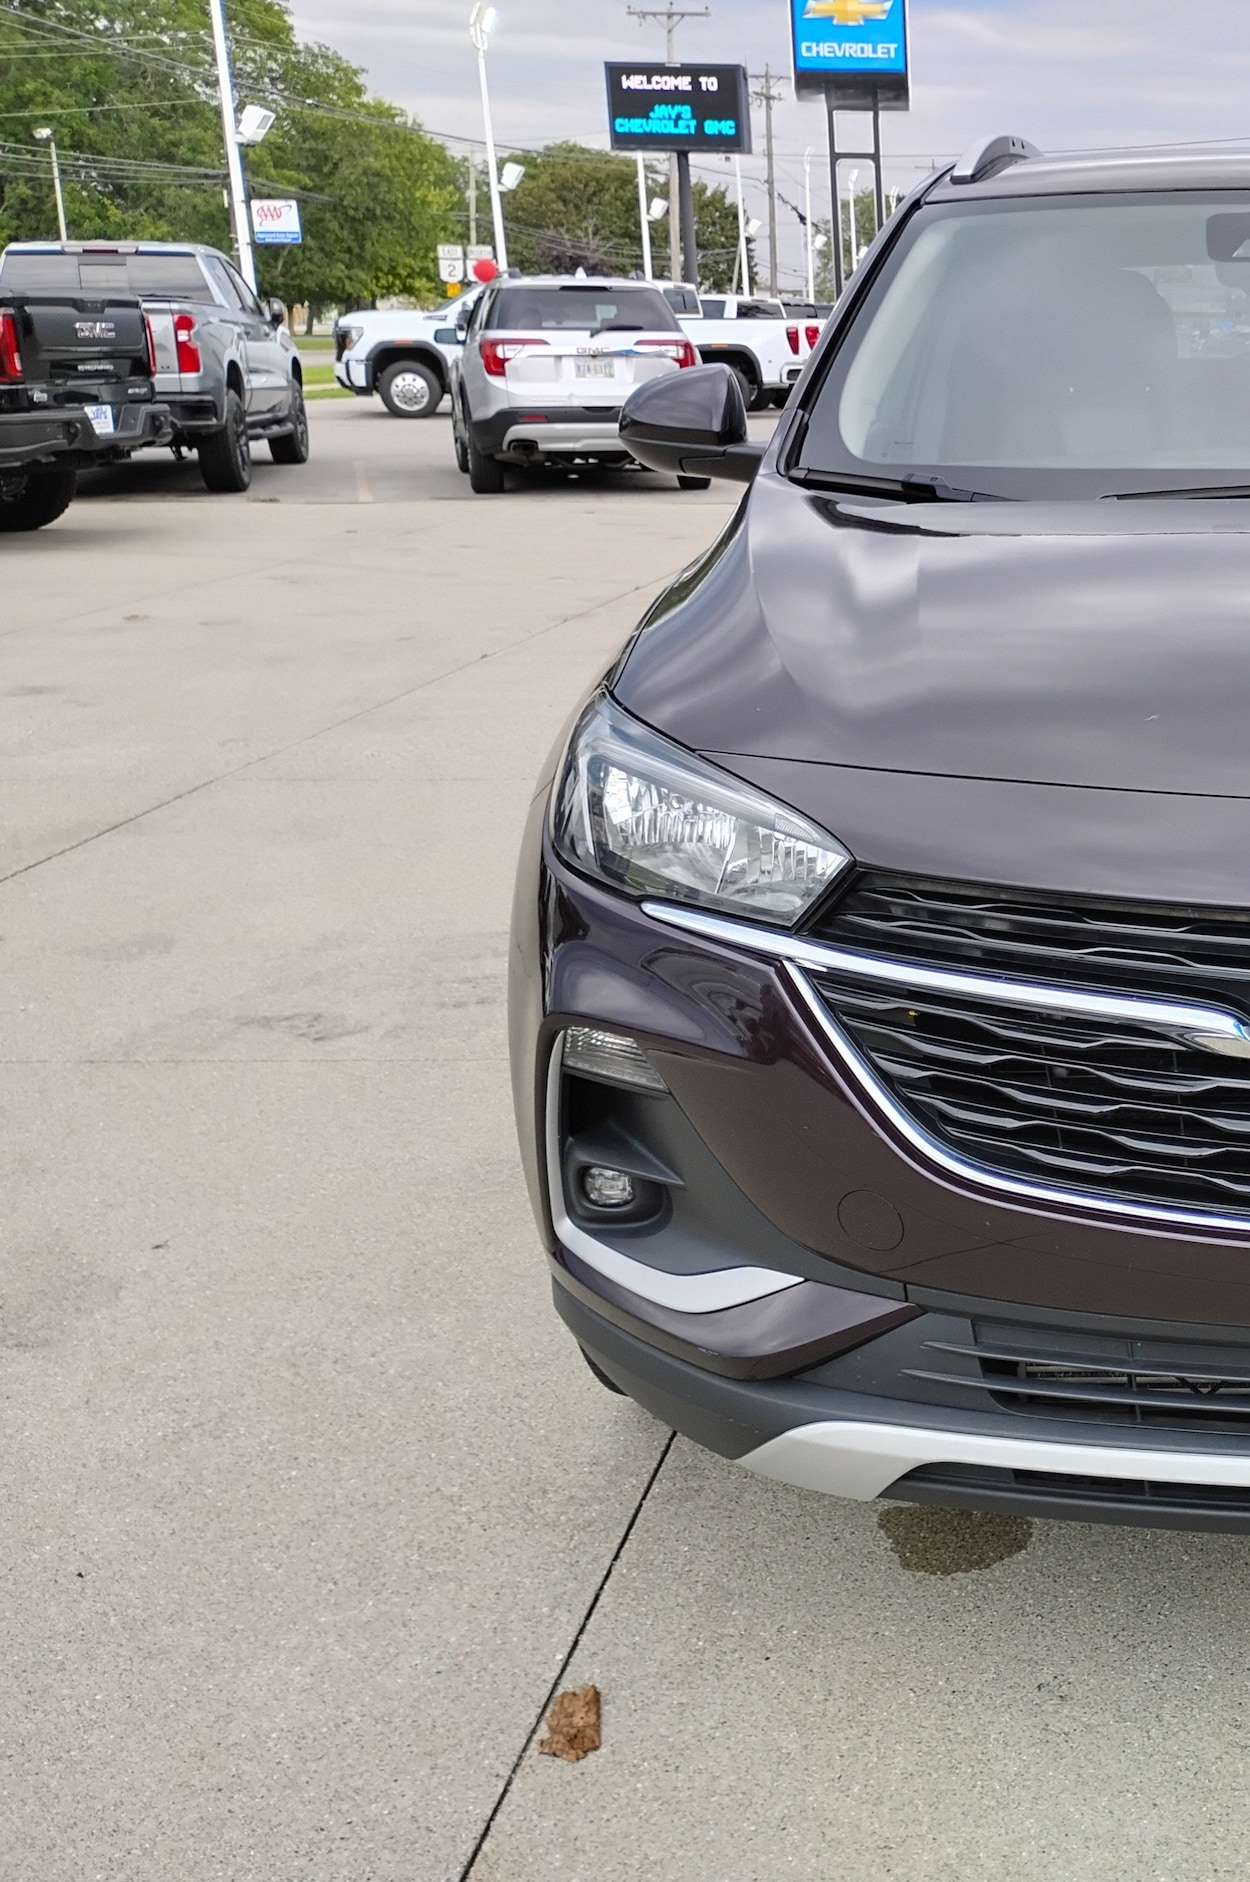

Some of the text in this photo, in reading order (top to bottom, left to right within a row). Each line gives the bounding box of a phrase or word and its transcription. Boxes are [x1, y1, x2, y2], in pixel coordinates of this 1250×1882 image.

[801, 41, 898, 59] CHEVROLET
[621, 74, 719, 91] WELCOME TO
[649, 104, 692, 119] JAY'S
[614, 117, 736, 135] CHEVROLET GMC
[257, 204, 282, 221] AAA
[447, 263, 457, 277] 2
[576, 347, 611, 355] GMC
